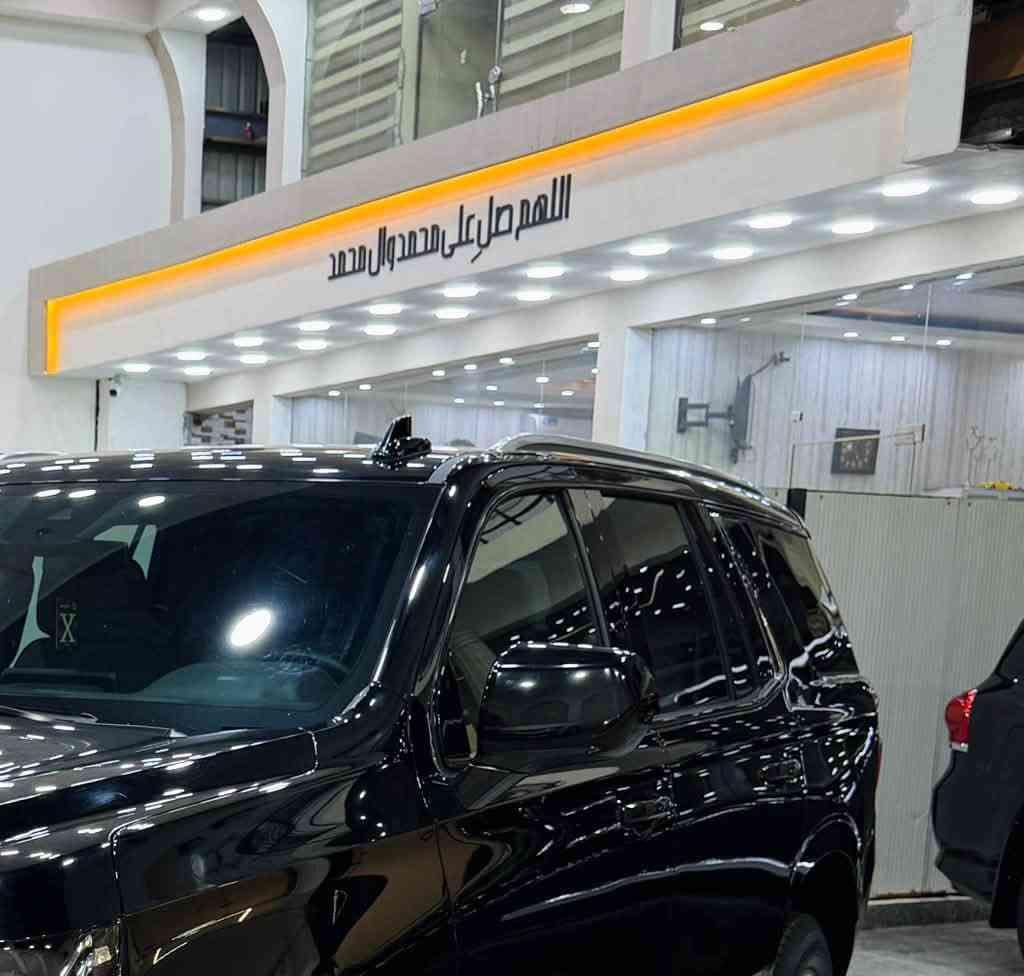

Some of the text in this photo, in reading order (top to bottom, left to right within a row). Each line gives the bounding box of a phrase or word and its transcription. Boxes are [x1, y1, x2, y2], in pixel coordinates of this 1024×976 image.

[515, 173, 573, 241] اللهم
[397, 223, 441, 262] محمد
[441, 204, 476, 259] على
[327, 245, 367, 281] محمد
